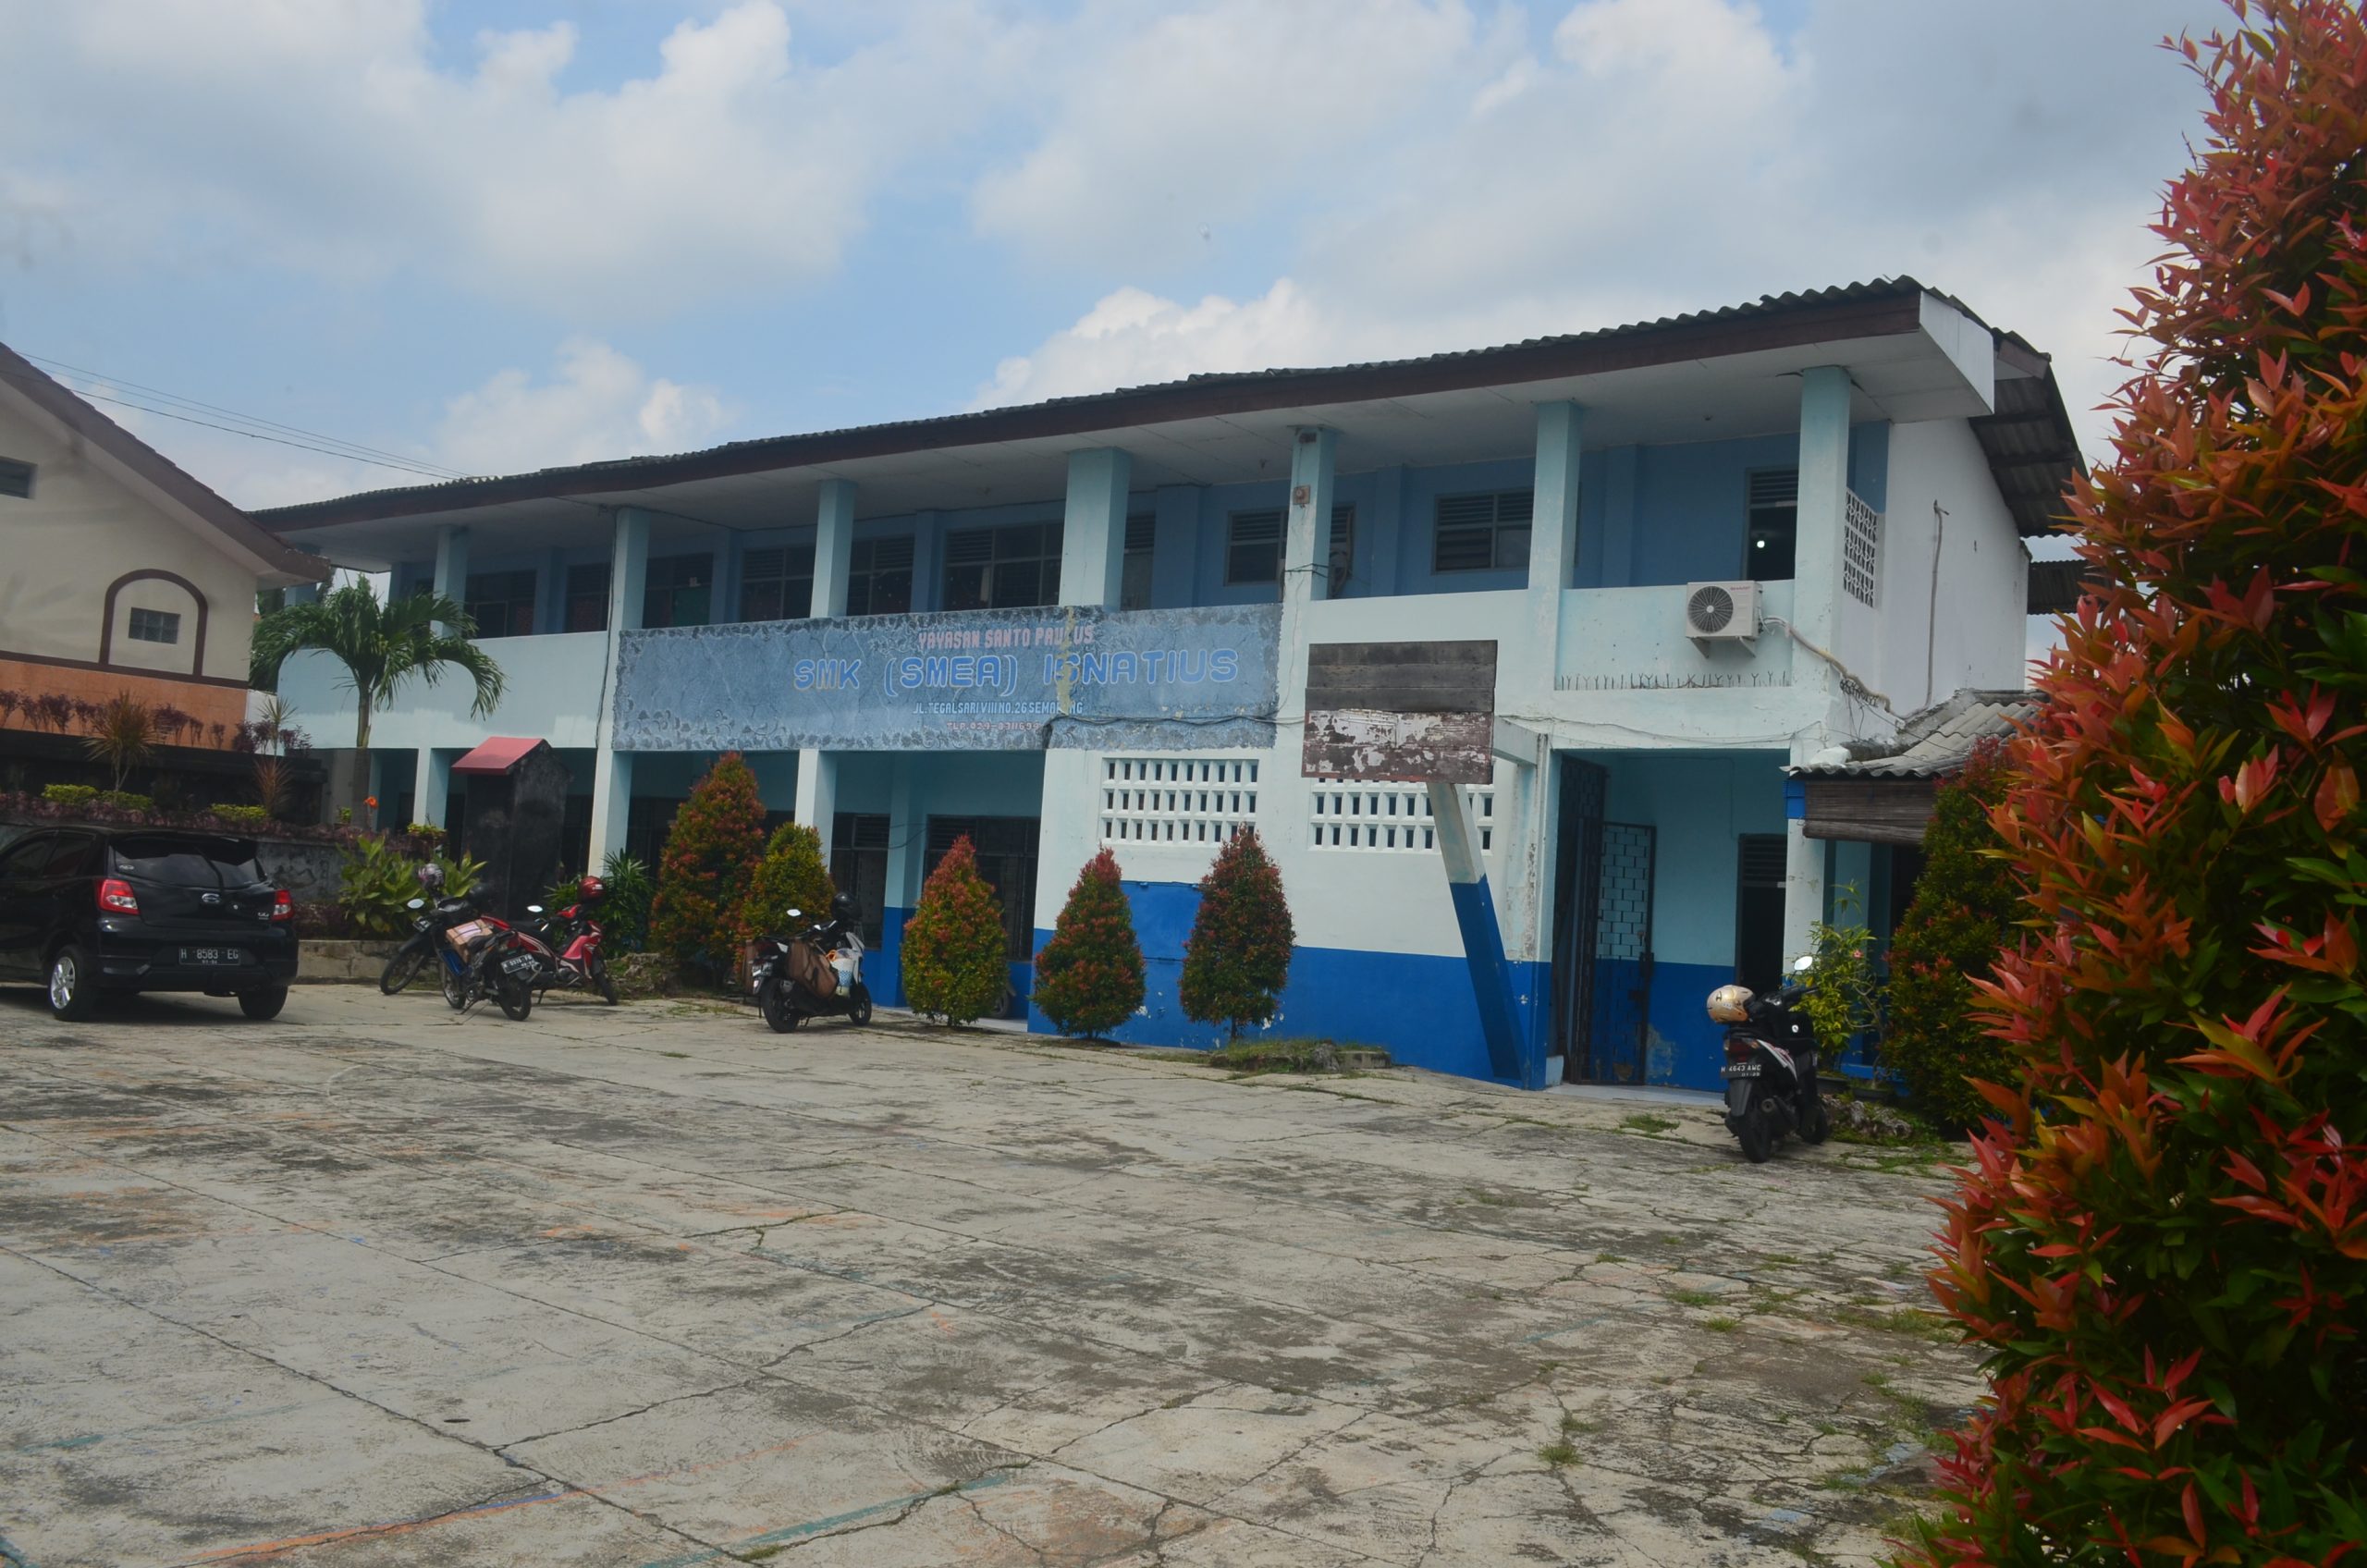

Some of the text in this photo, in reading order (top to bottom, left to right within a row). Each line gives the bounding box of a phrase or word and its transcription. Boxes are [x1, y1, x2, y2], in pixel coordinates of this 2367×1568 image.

[918, 625, 1095, 649] YAYASAN SANTO PAUUS
[793, 658, 861, 690] SMK
[884, 655, 1017, 697] (SMEA)
[180, 948, 187, 960] H
